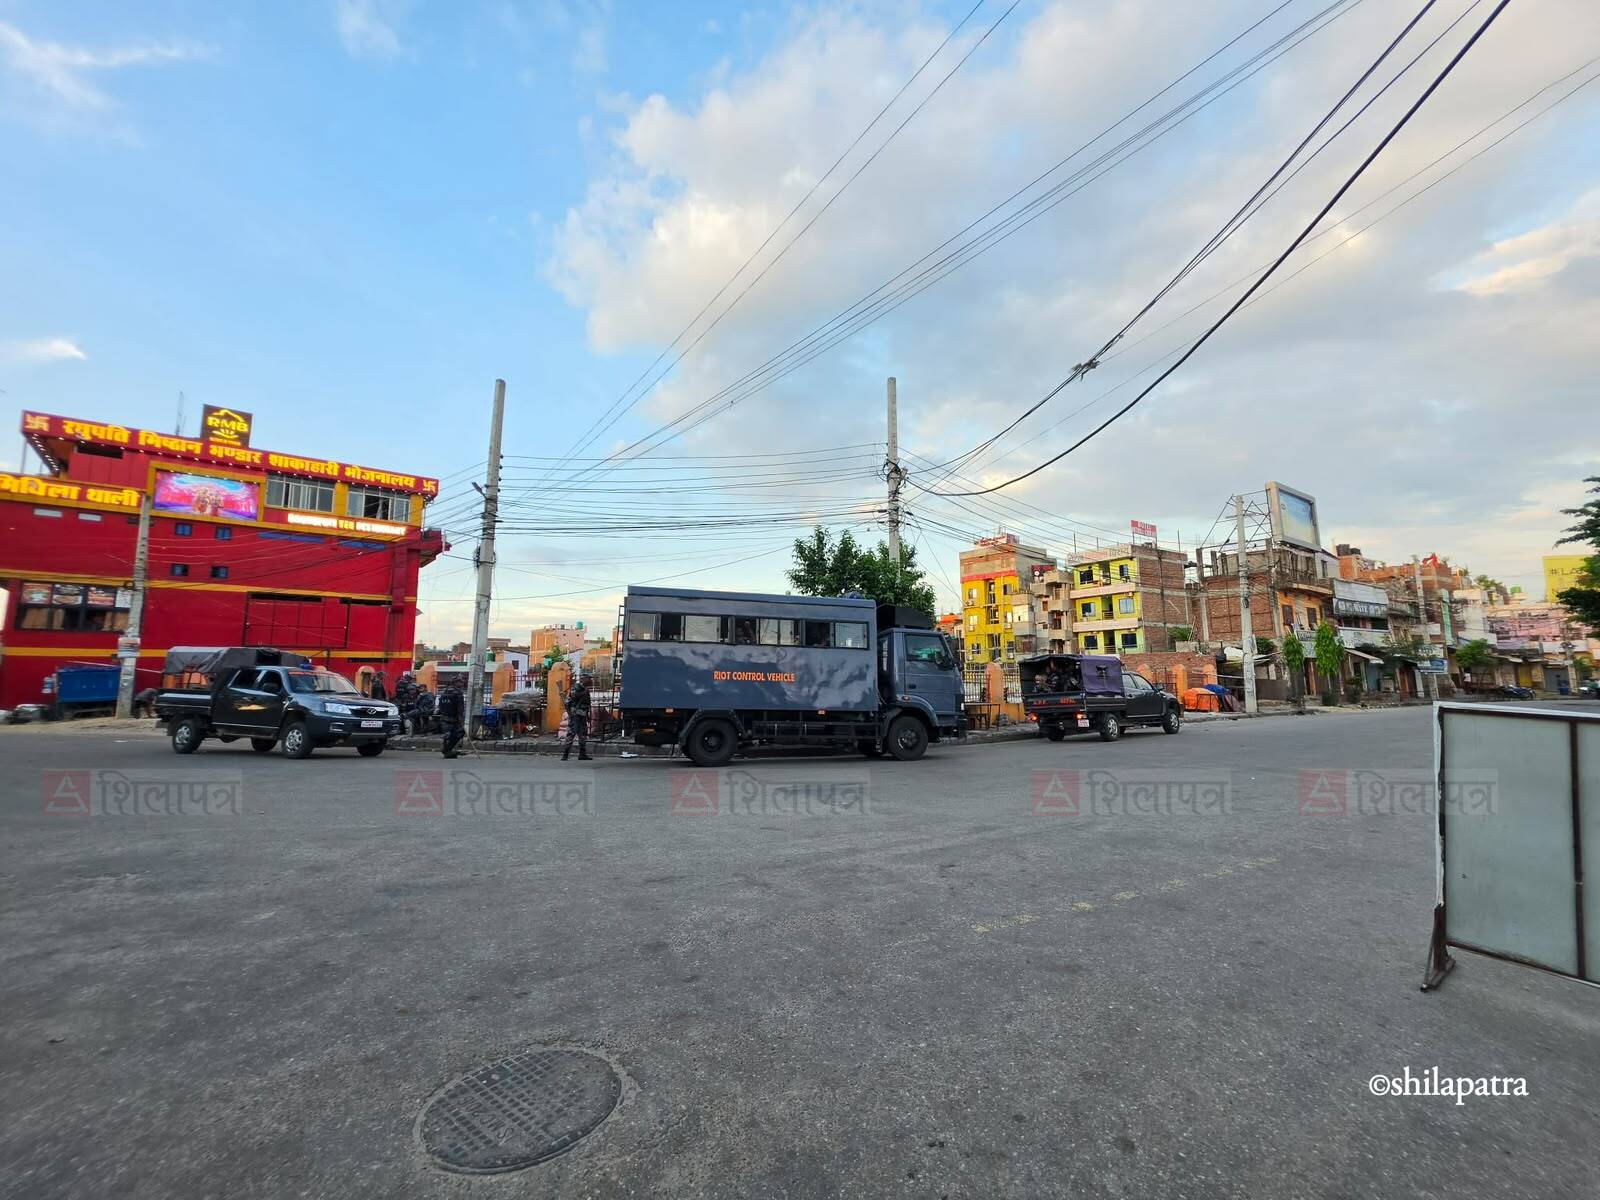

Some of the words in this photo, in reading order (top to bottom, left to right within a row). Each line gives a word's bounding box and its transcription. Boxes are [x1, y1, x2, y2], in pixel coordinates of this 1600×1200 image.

[713, 670, 731, 681] RIOT
[732, 671, 766, 682] CONTROL
[766, 672, 796, 683] VEHICLE
